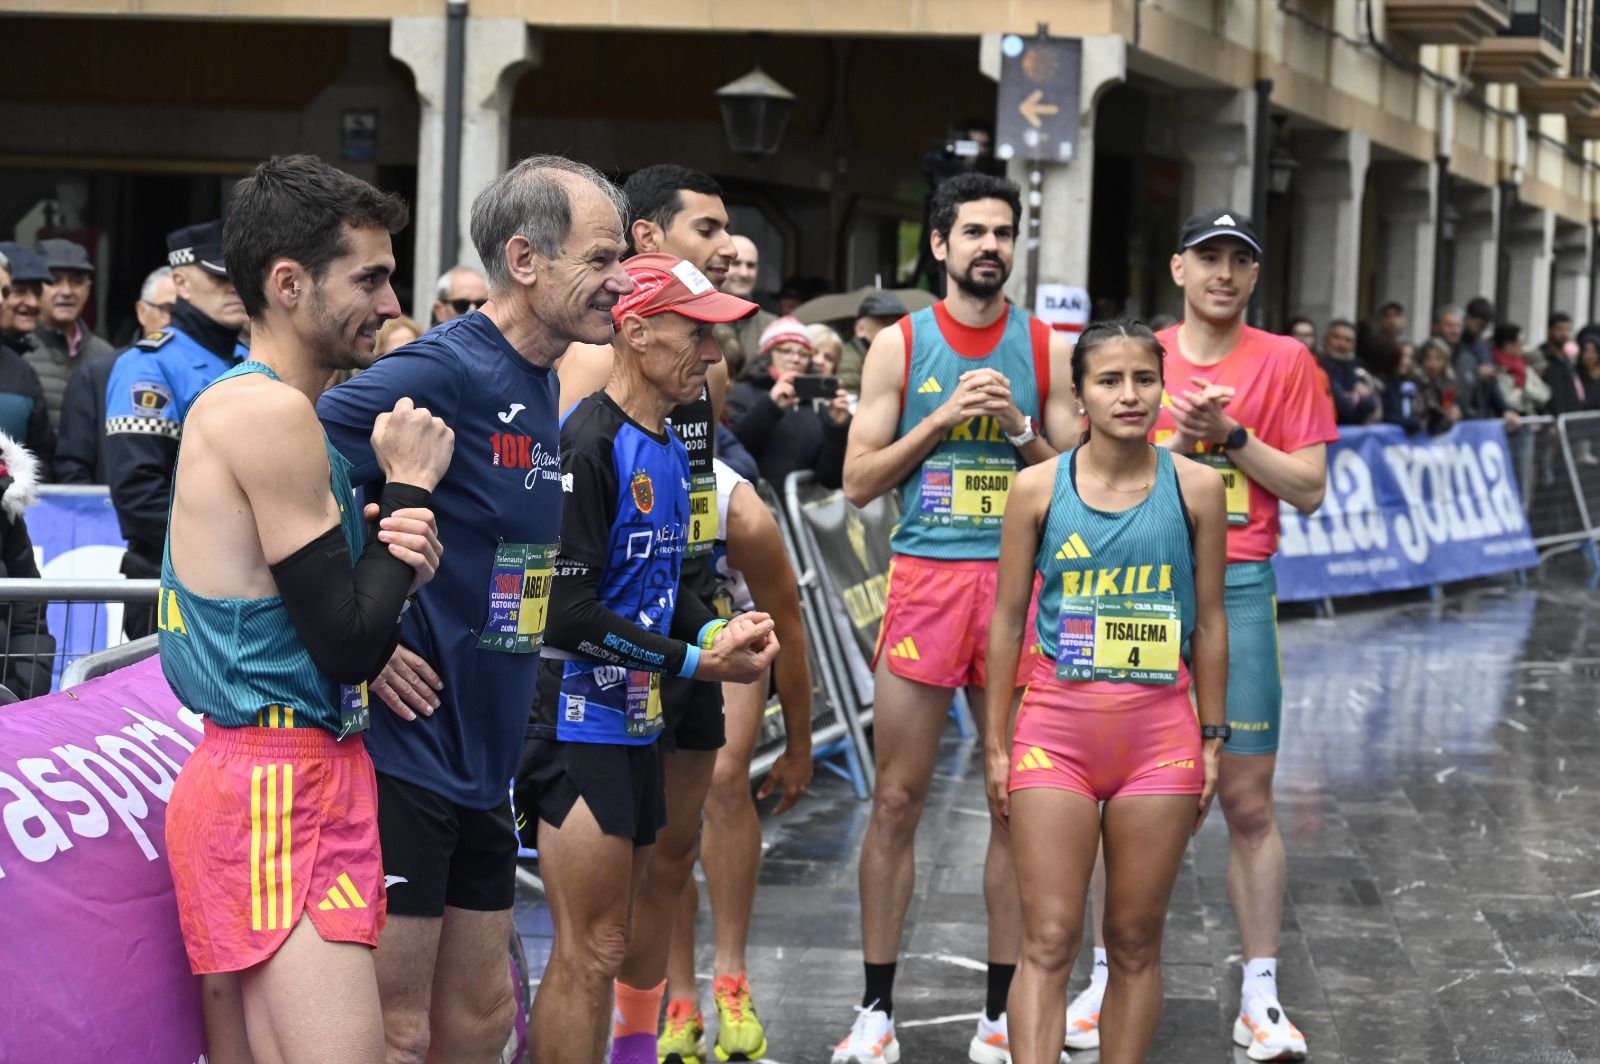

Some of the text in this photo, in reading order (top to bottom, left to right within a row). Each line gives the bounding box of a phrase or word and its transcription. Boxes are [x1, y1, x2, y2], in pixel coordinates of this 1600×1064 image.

[490, 433, 532, 469] 10K
[685, 439, 707, 451] OODS
[542, 470, 557, 480] CIUDAD
[1220, 473, 1235, 488] NO
[965, 475, 1008, 491] ROSADO
[981, 495, 992, 514] 5
[693, 520, 700, 540] 8
[497, 555, 523, 564] Telenauto
[561, 567, 589, 576] BTT
[523, 575, 542, 599] ABEL
[492, 592, 513, 600] CIUDAD
[491, 601, 520, 609] ASTORGA
[509, 610, 518, 621] 26
[537, 604, 544, 632] 1
[1062, 618, 1093, 634] 10K
[1105, 622, 1167, 642] TISALEMA
[1059, 639, 1094, 647] ASTORGA
[1128, 647, 1140, 667] 4
[1130, 671, 1174, 680] CAJA RURAL
